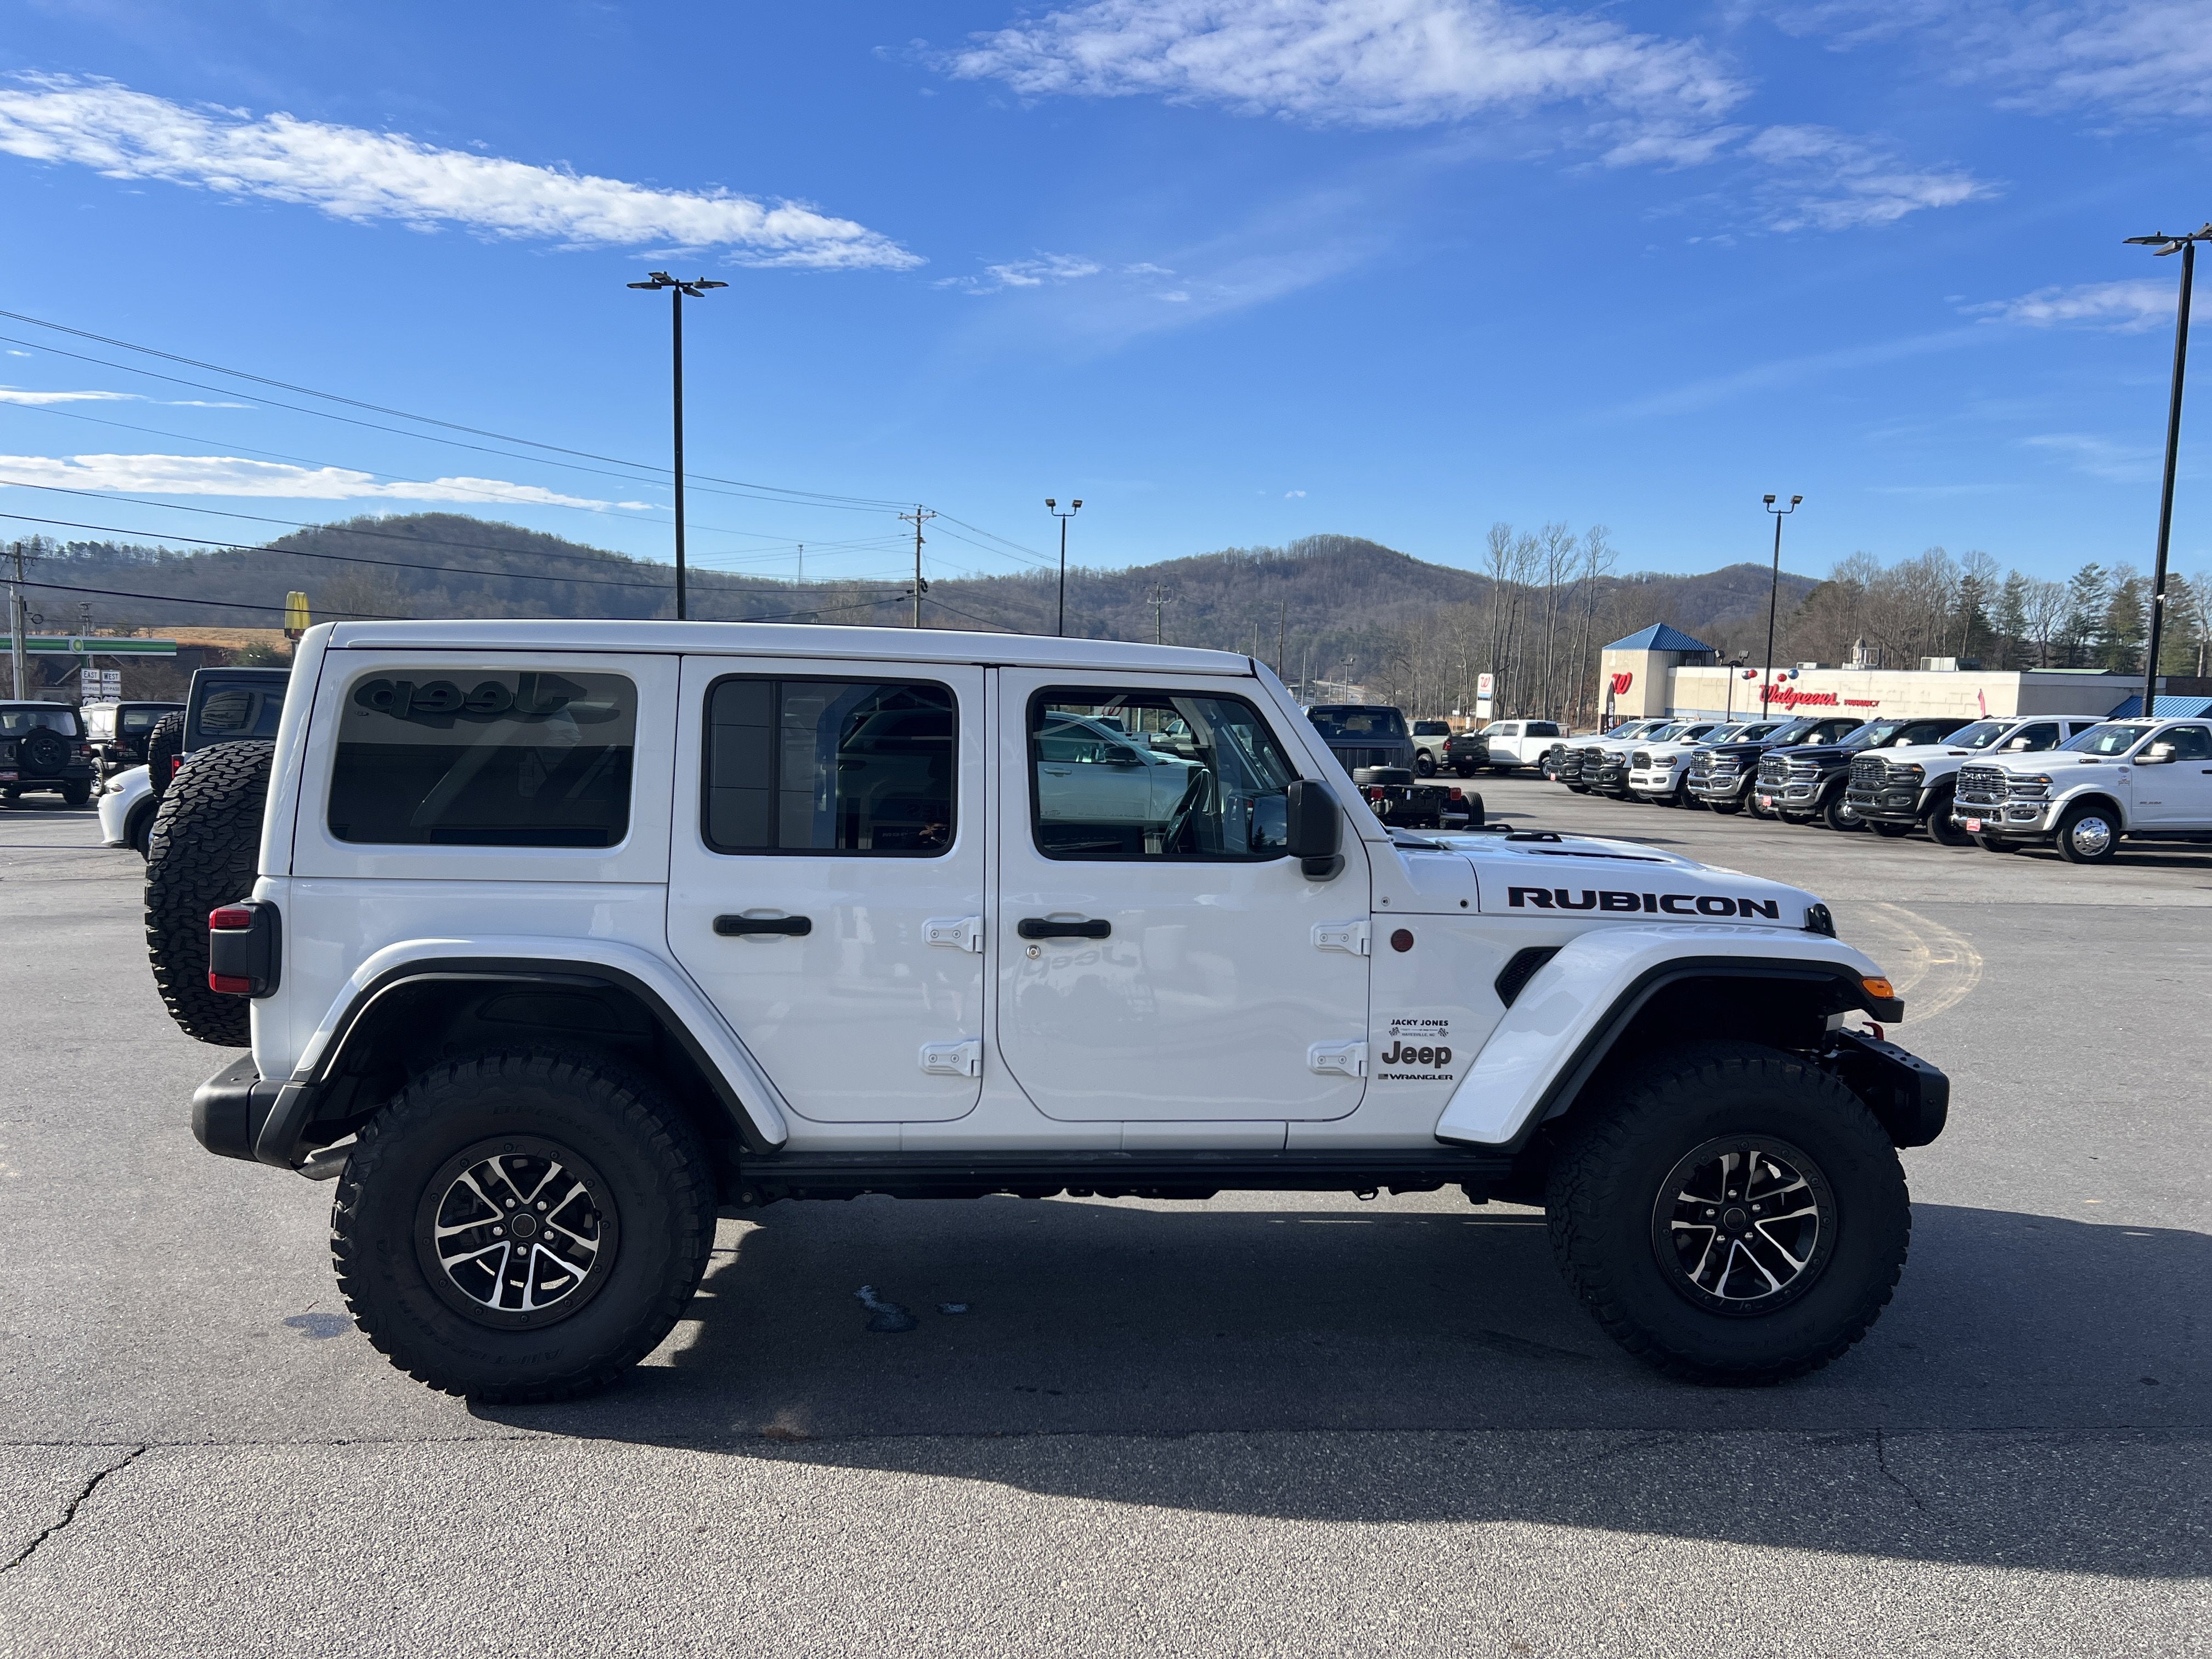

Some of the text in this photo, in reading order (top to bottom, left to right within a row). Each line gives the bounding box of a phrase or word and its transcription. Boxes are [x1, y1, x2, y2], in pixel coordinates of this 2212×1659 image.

[1759, 684, 1839, 711] Walgreens
[1508, 887, 1780, 919] RUBICON
[1382, 1041, 1452, 1069] Jeep
